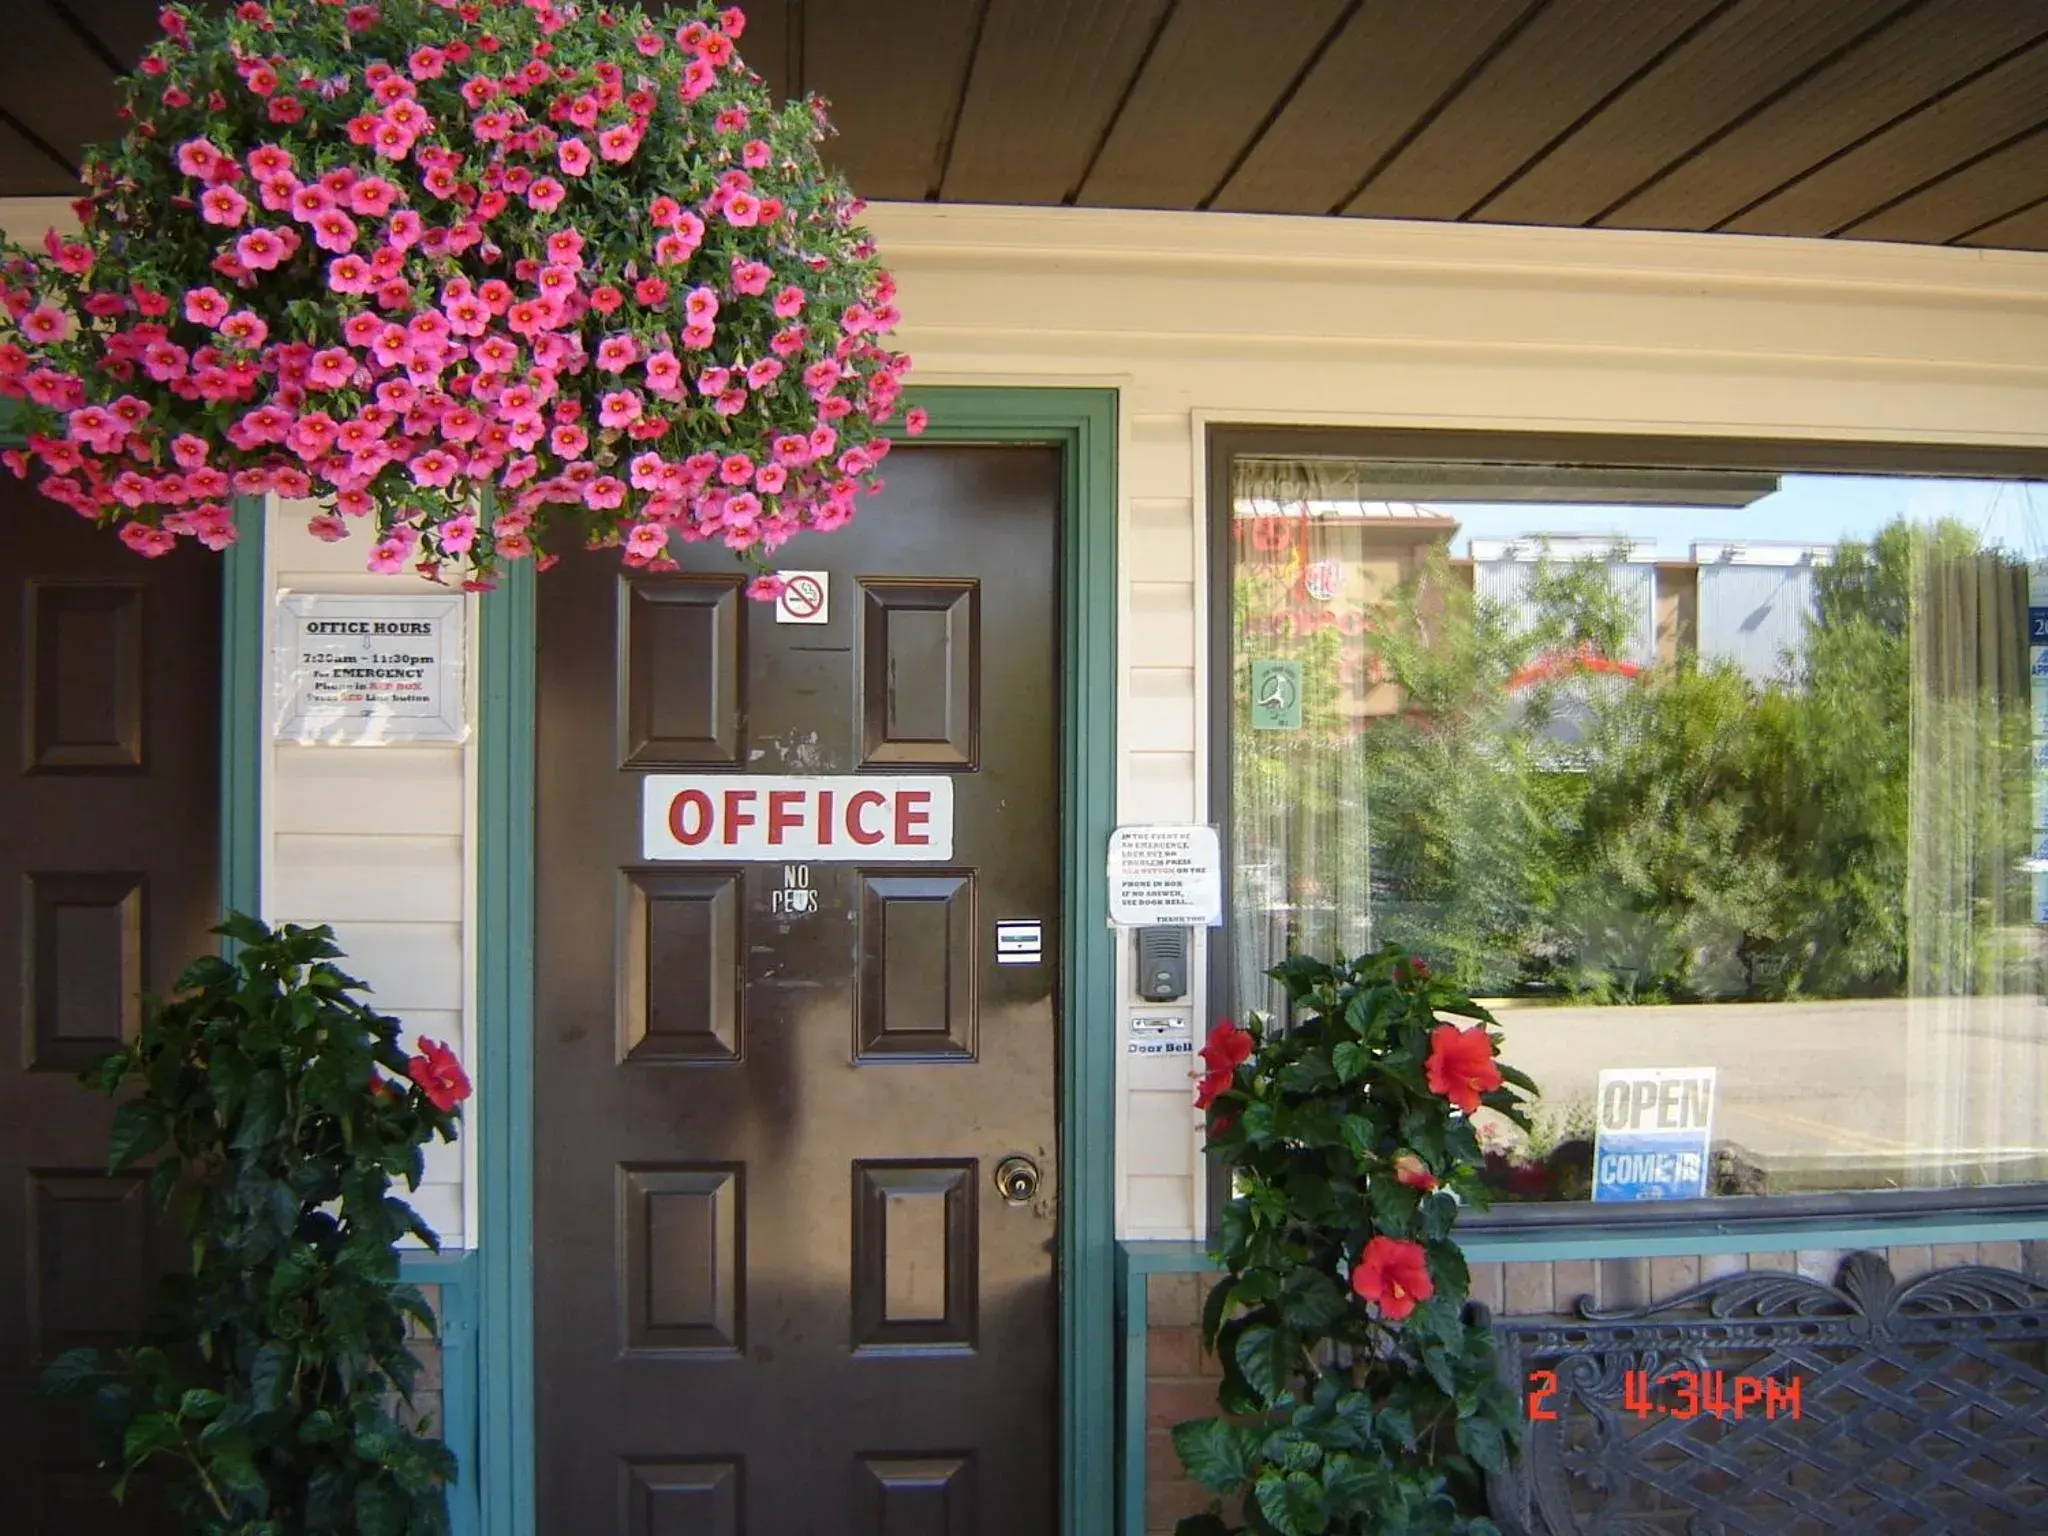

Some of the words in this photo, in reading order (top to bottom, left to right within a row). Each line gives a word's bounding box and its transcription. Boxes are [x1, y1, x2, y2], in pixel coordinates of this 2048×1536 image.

[306, 622, 370, 633] OFFICE
[373, 622, 432, 634] HOURS
[372, 654, 434, 666] 11:30pm
[333, 668, 424, 678] EMERGENCY
[668, 789, 931, 846] OFFICE
[784, 864, 809, 888] NO
[1128, 1044, 1162, 1054] Door
[1165, 1042, 1193, 1052] Bell
[1602, 1079, 1711, 1130] OPEN
[1601, 1153, 1674, 1185] COME
